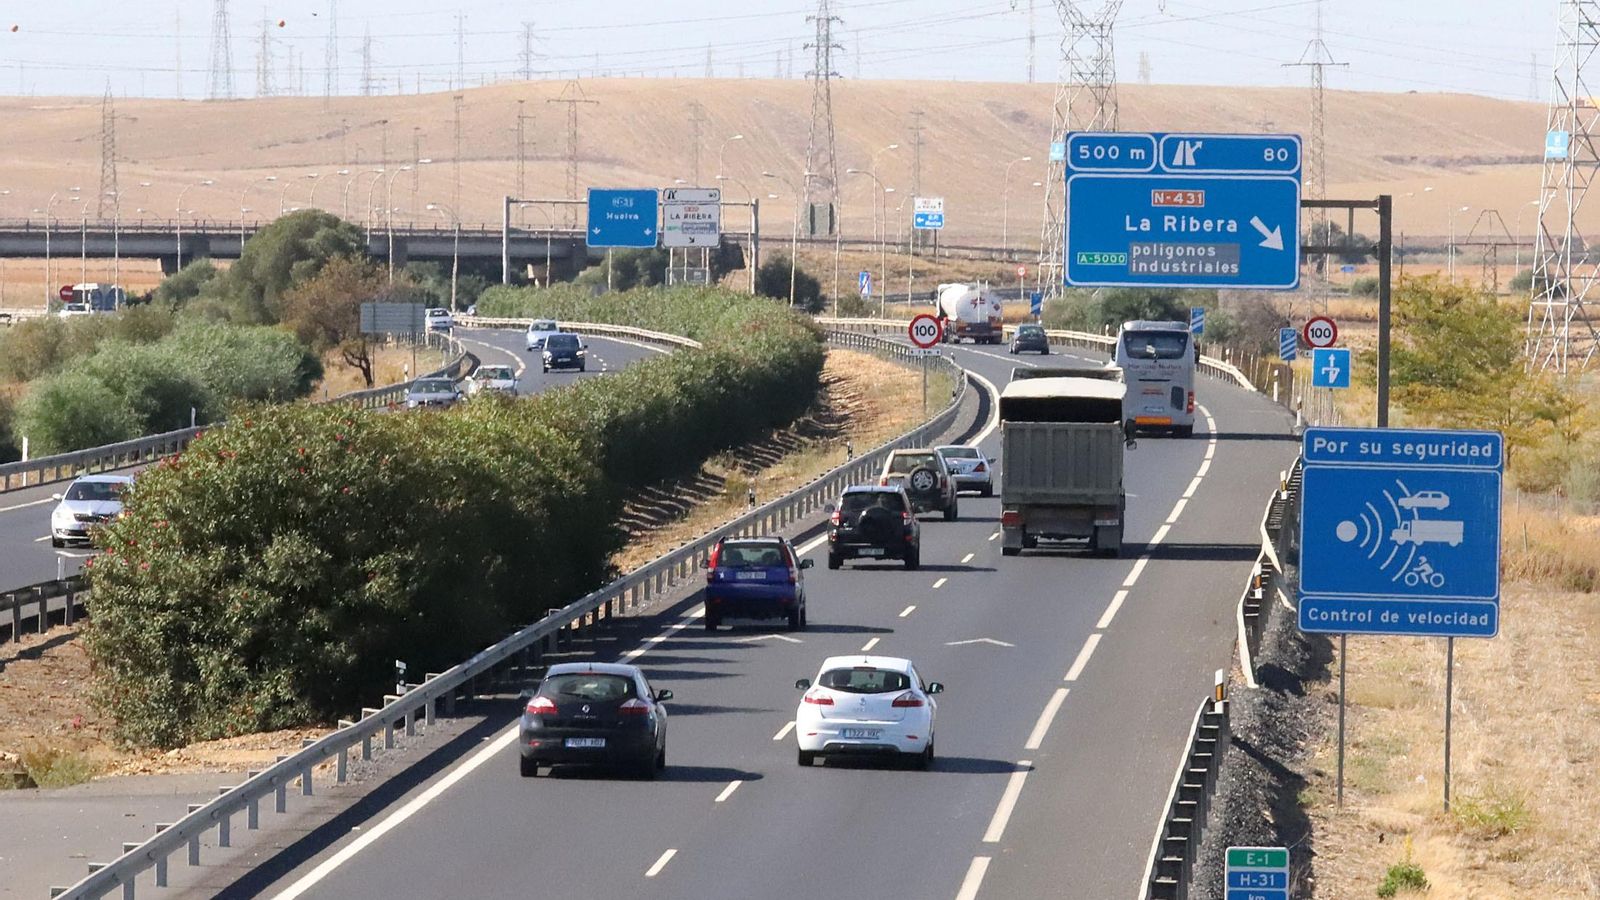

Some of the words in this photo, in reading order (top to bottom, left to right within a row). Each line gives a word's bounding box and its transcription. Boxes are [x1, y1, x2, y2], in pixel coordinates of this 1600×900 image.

[1079, 145, 1120, 160] 500
[1130, 149, 1146, 160] m
[1263, 148, 1289, 162] 80
[1154, 192, 1204, 205] N-431
[606, 211, 640, 220] Huelva
[1125, 215, 1151, 232] La
[1163, 215, 1238, 233] Ribera
[1079, 254, 1126, 264] A-5000
[1131, 259, 1239, 274] industriales
[914, 325, 936, 337] 100
[1310, 328, 1332, 339] 100
[1313, 437, 1349, 454] Por
[1359, 443, 1381, 455] su
[1392, 440, 1492, 460] seguridad
[1308, 607, 1372, 623] Control
[1380, 610, 1400, 623] de
[1408, 611, 1489, 626] velocidad
[1246, 853, 1269, 865] E-1
[1240, 874, 1275, 886] H-31
